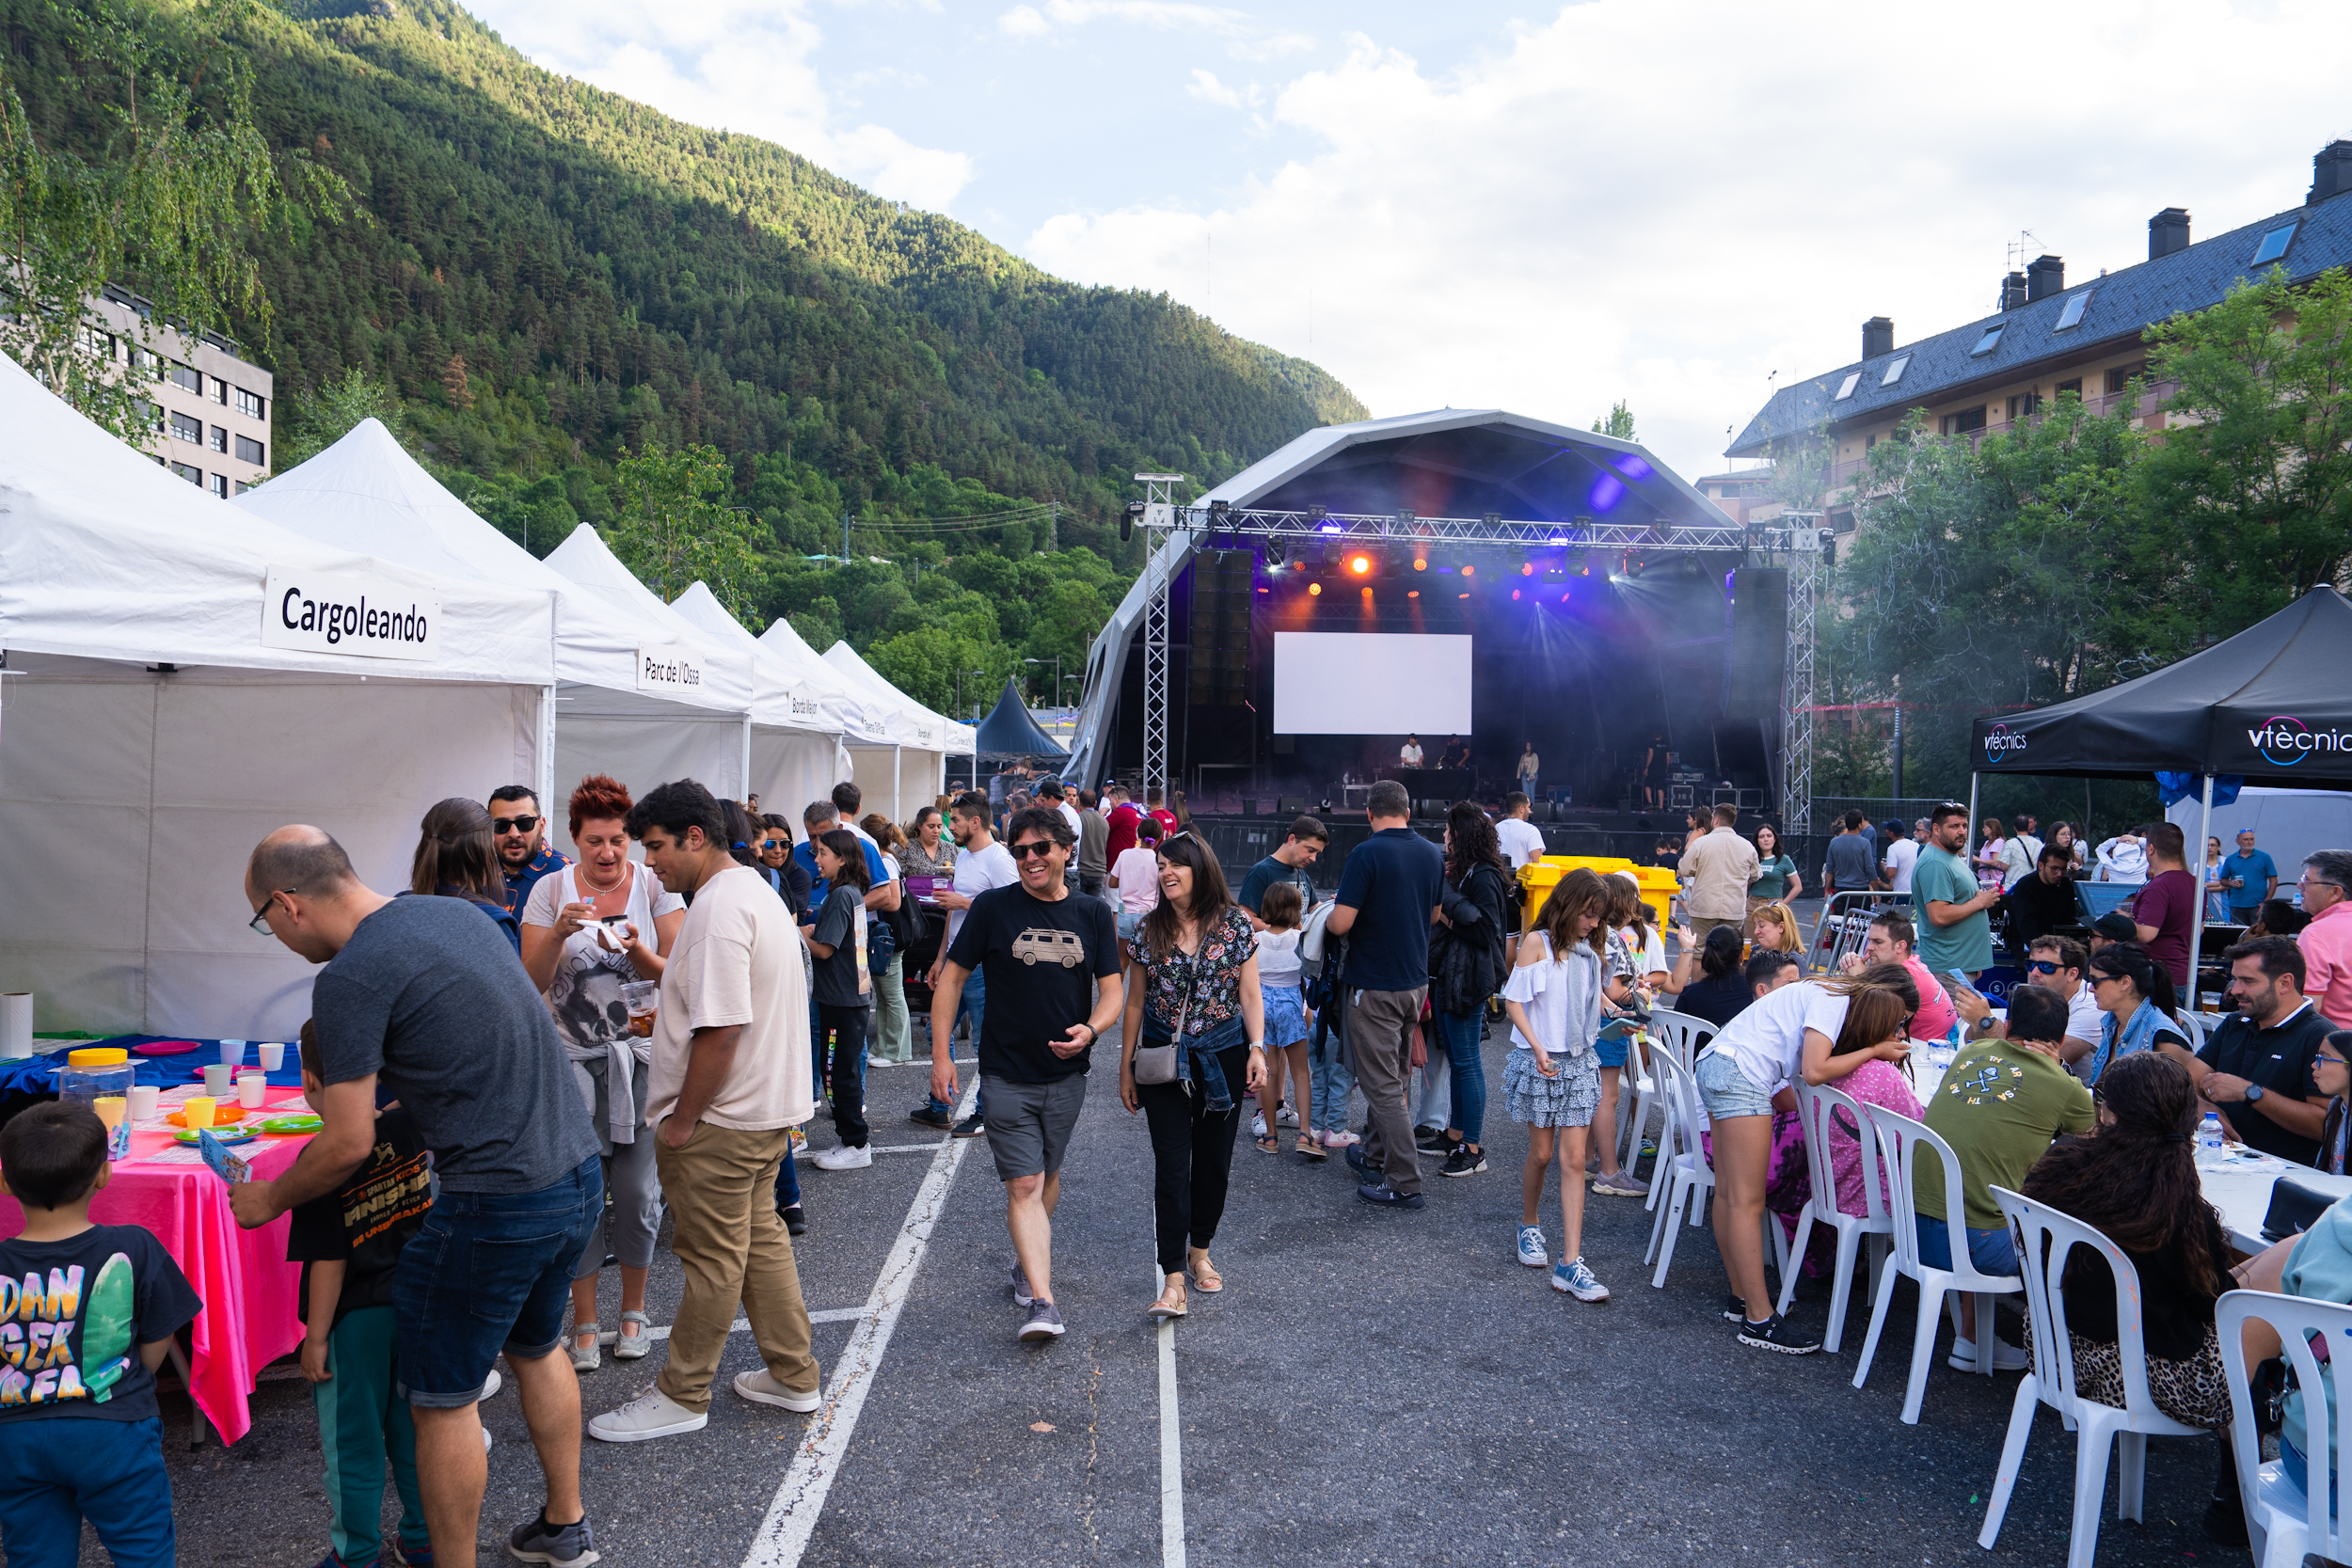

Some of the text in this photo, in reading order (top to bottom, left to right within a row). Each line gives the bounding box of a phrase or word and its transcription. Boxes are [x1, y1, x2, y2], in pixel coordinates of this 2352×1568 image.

[282, 587, 426, 644] Cargoleando
[645, 657, 699, 685] Parc de l'Ossa
[792, 697, 806, 714] Borda
[827, 1028, 837, 1071] MICKEY
[1960, 1055, 1985, 1070] SAVE
[367, 1164, 421, 1197] SPARTAN KIDS
[352, 1234, 365, 1248] BE
[0, 1264, 85, 1324] DAN
